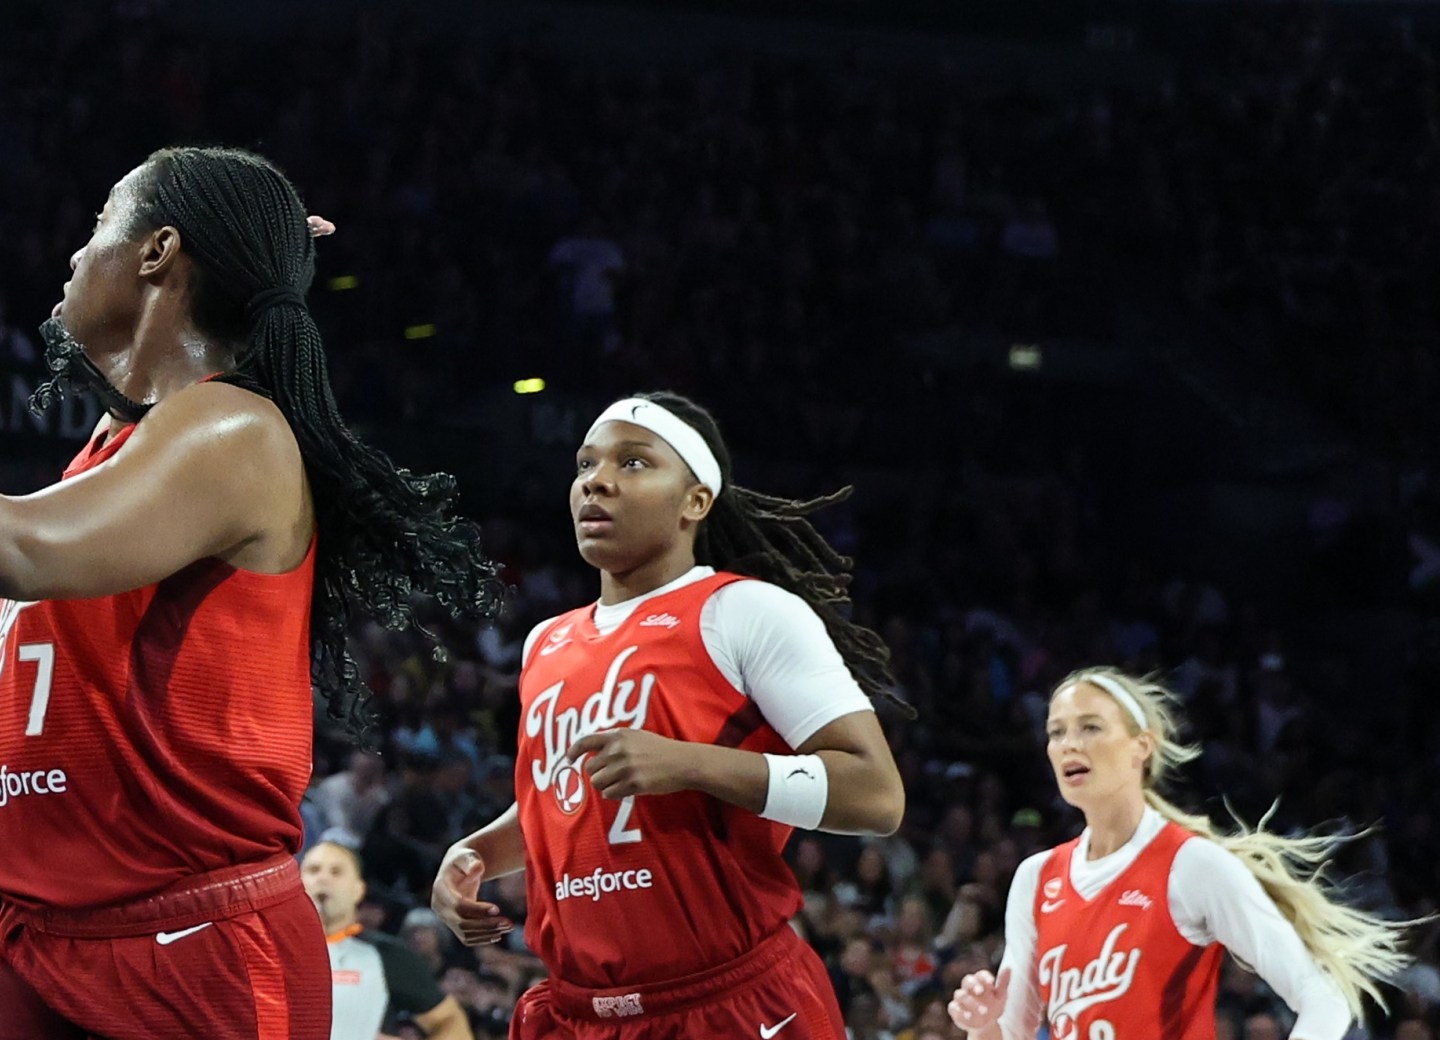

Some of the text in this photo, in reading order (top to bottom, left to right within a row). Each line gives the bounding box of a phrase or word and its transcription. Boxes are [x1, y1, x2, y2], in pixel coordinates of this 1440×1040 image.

[18, 642, 55, 737] 7
[525, 646, 656, 792] Indy
[1038, 922, 1142, 1023] Indy
